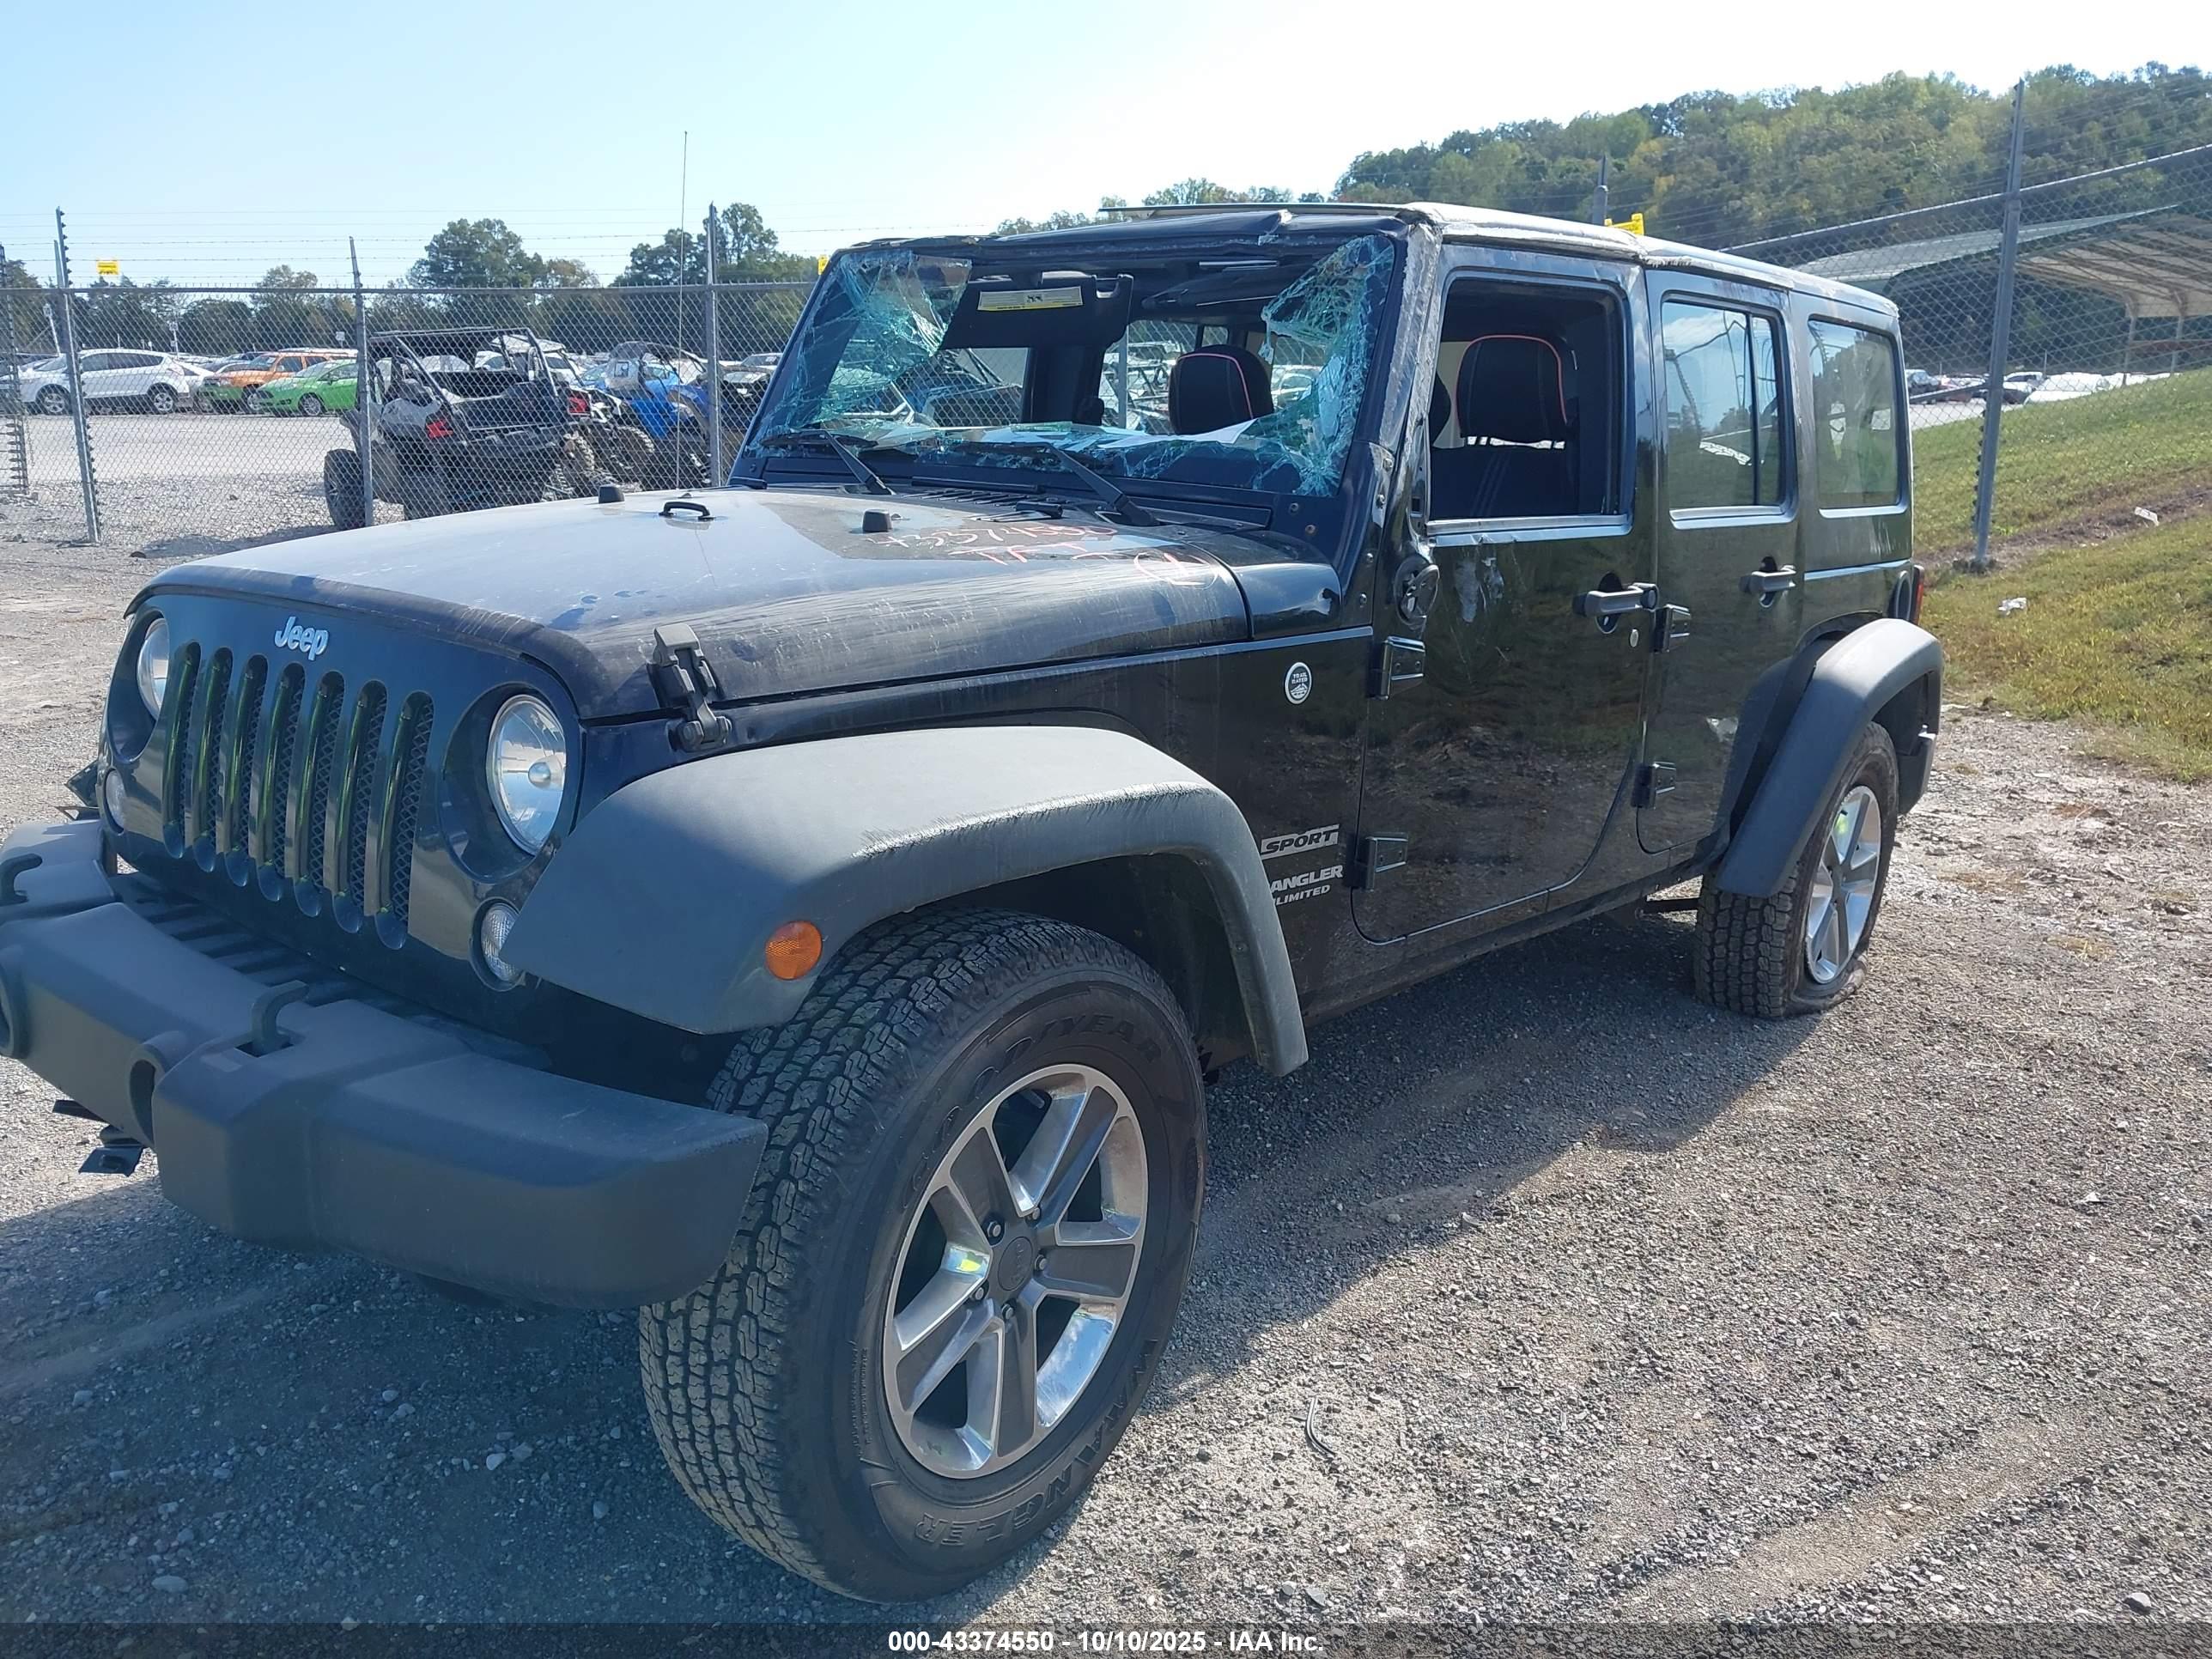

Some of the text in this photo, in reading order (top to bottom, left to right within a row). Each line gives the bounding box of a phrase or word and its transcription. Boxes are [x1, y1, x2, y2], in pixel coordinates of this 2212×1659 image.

[274, 616, 329, 661] Jeep
[1262, 830, 1339, 854] SPORT
[1271, 865, 1344, 893] ANGLER
[1273, 884, 1331, 906] LIMITED
